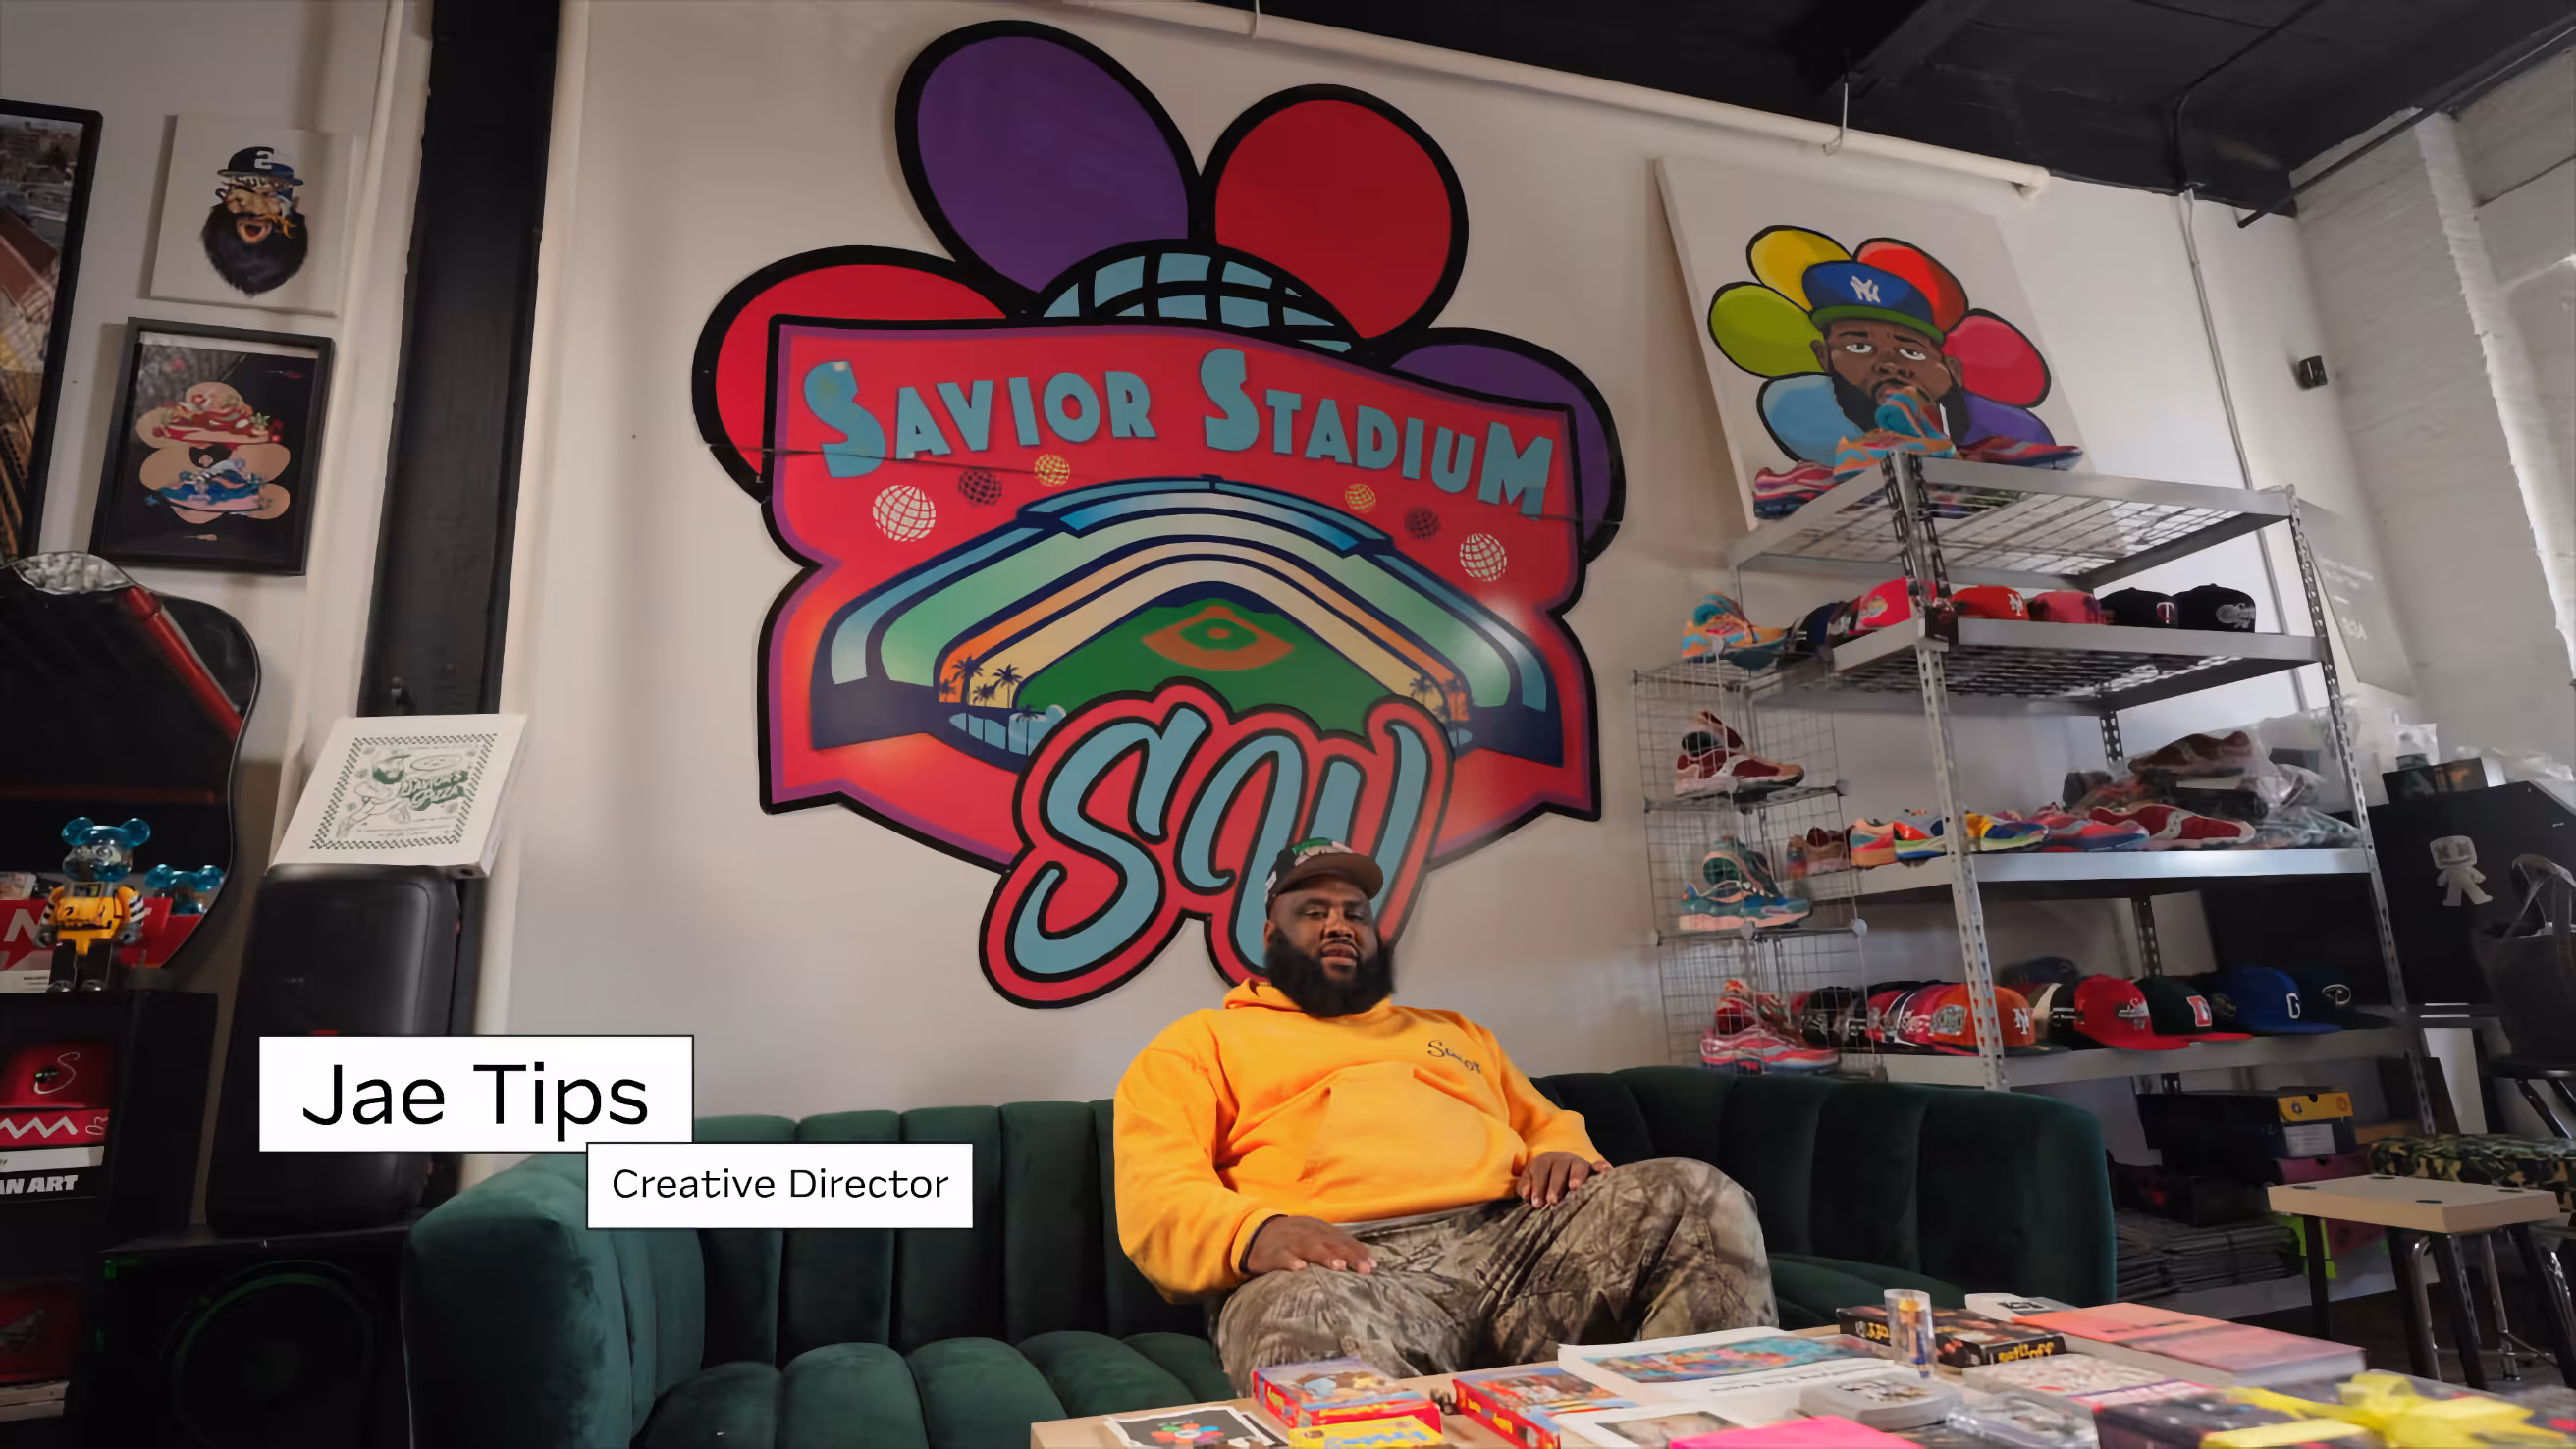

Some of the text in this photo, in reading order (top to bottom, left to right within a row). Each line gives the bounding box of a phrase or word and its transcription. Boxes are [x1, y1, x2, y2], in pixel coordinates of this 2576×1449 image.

[1850, 275, 1880, 303] NY
[804, 348, 1554, 520] SAVIOR STADIUM
[2285, 993, 2301, 1019] G
[27, 1174, 79, 1193] ART
